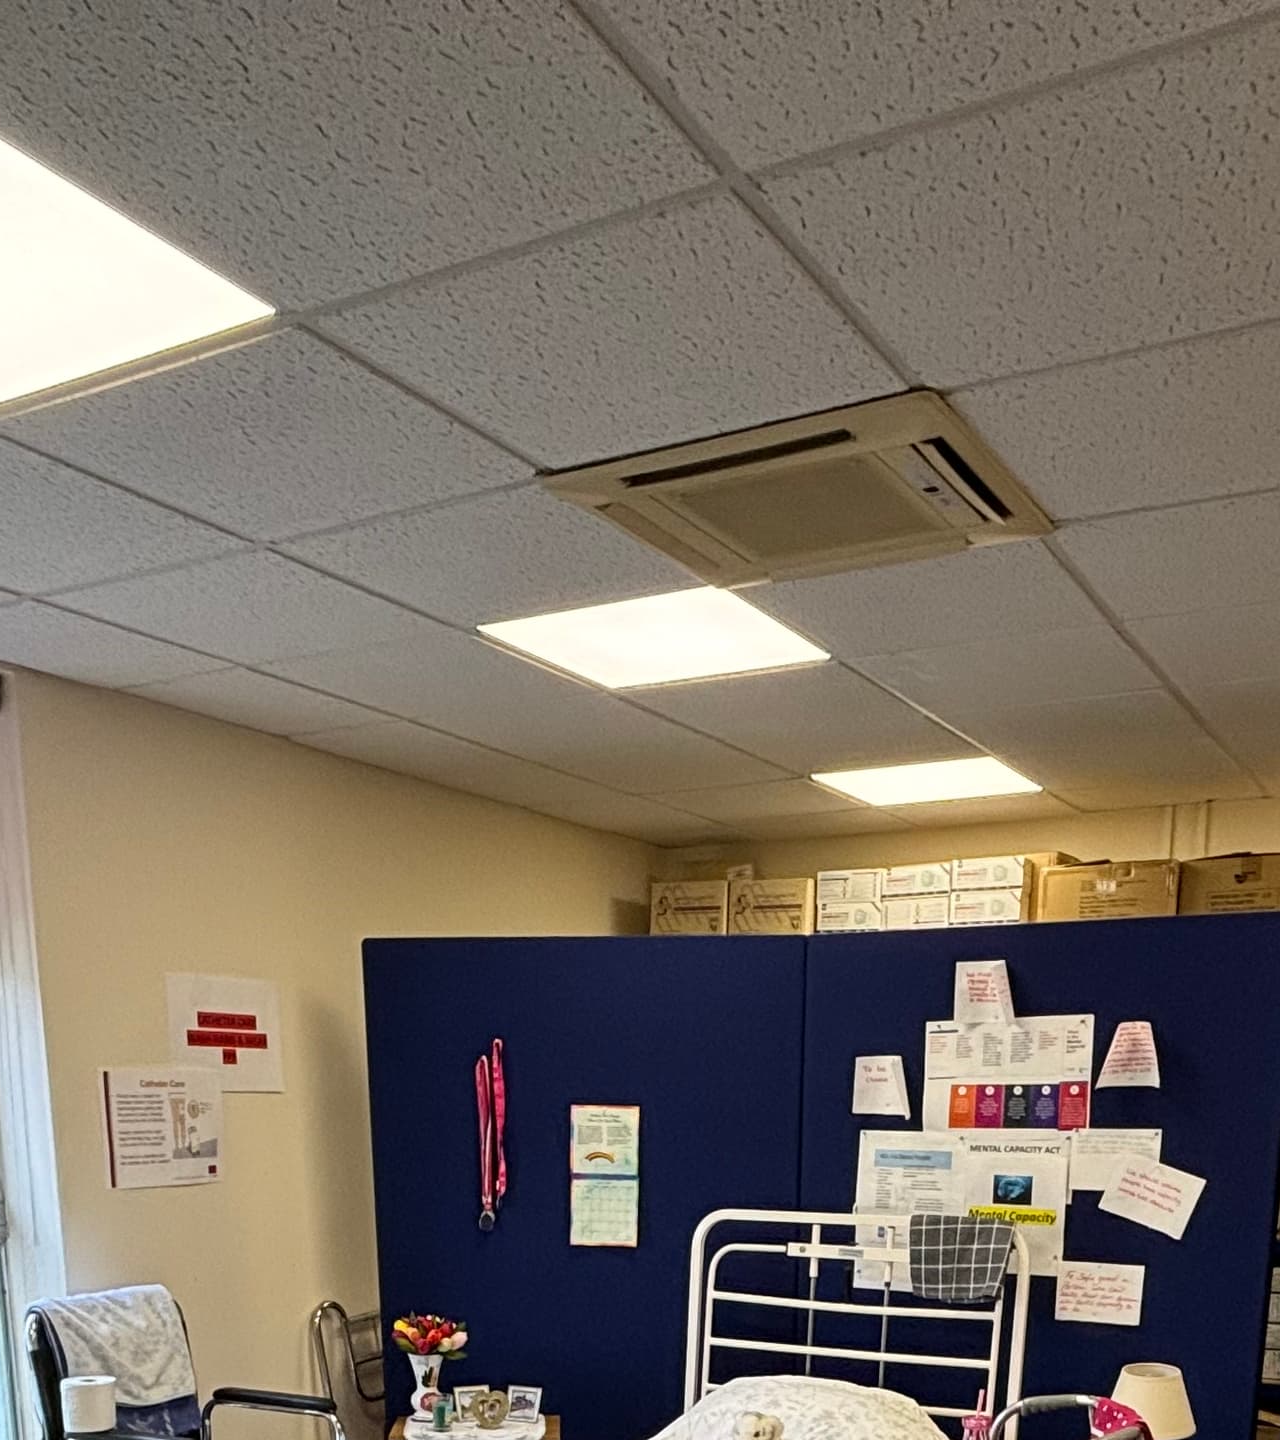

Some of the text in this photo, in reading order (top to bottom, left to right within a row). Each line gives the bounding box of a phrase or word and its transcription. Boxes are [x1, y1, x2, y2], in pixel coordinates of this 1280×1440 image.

[140, 1079, 185, 1088] Catheter Care
[970, 1145, 1061, 1154] MENTAL CAPACITY ACT
[1009, 1211, 1057, 1225] Capacity
